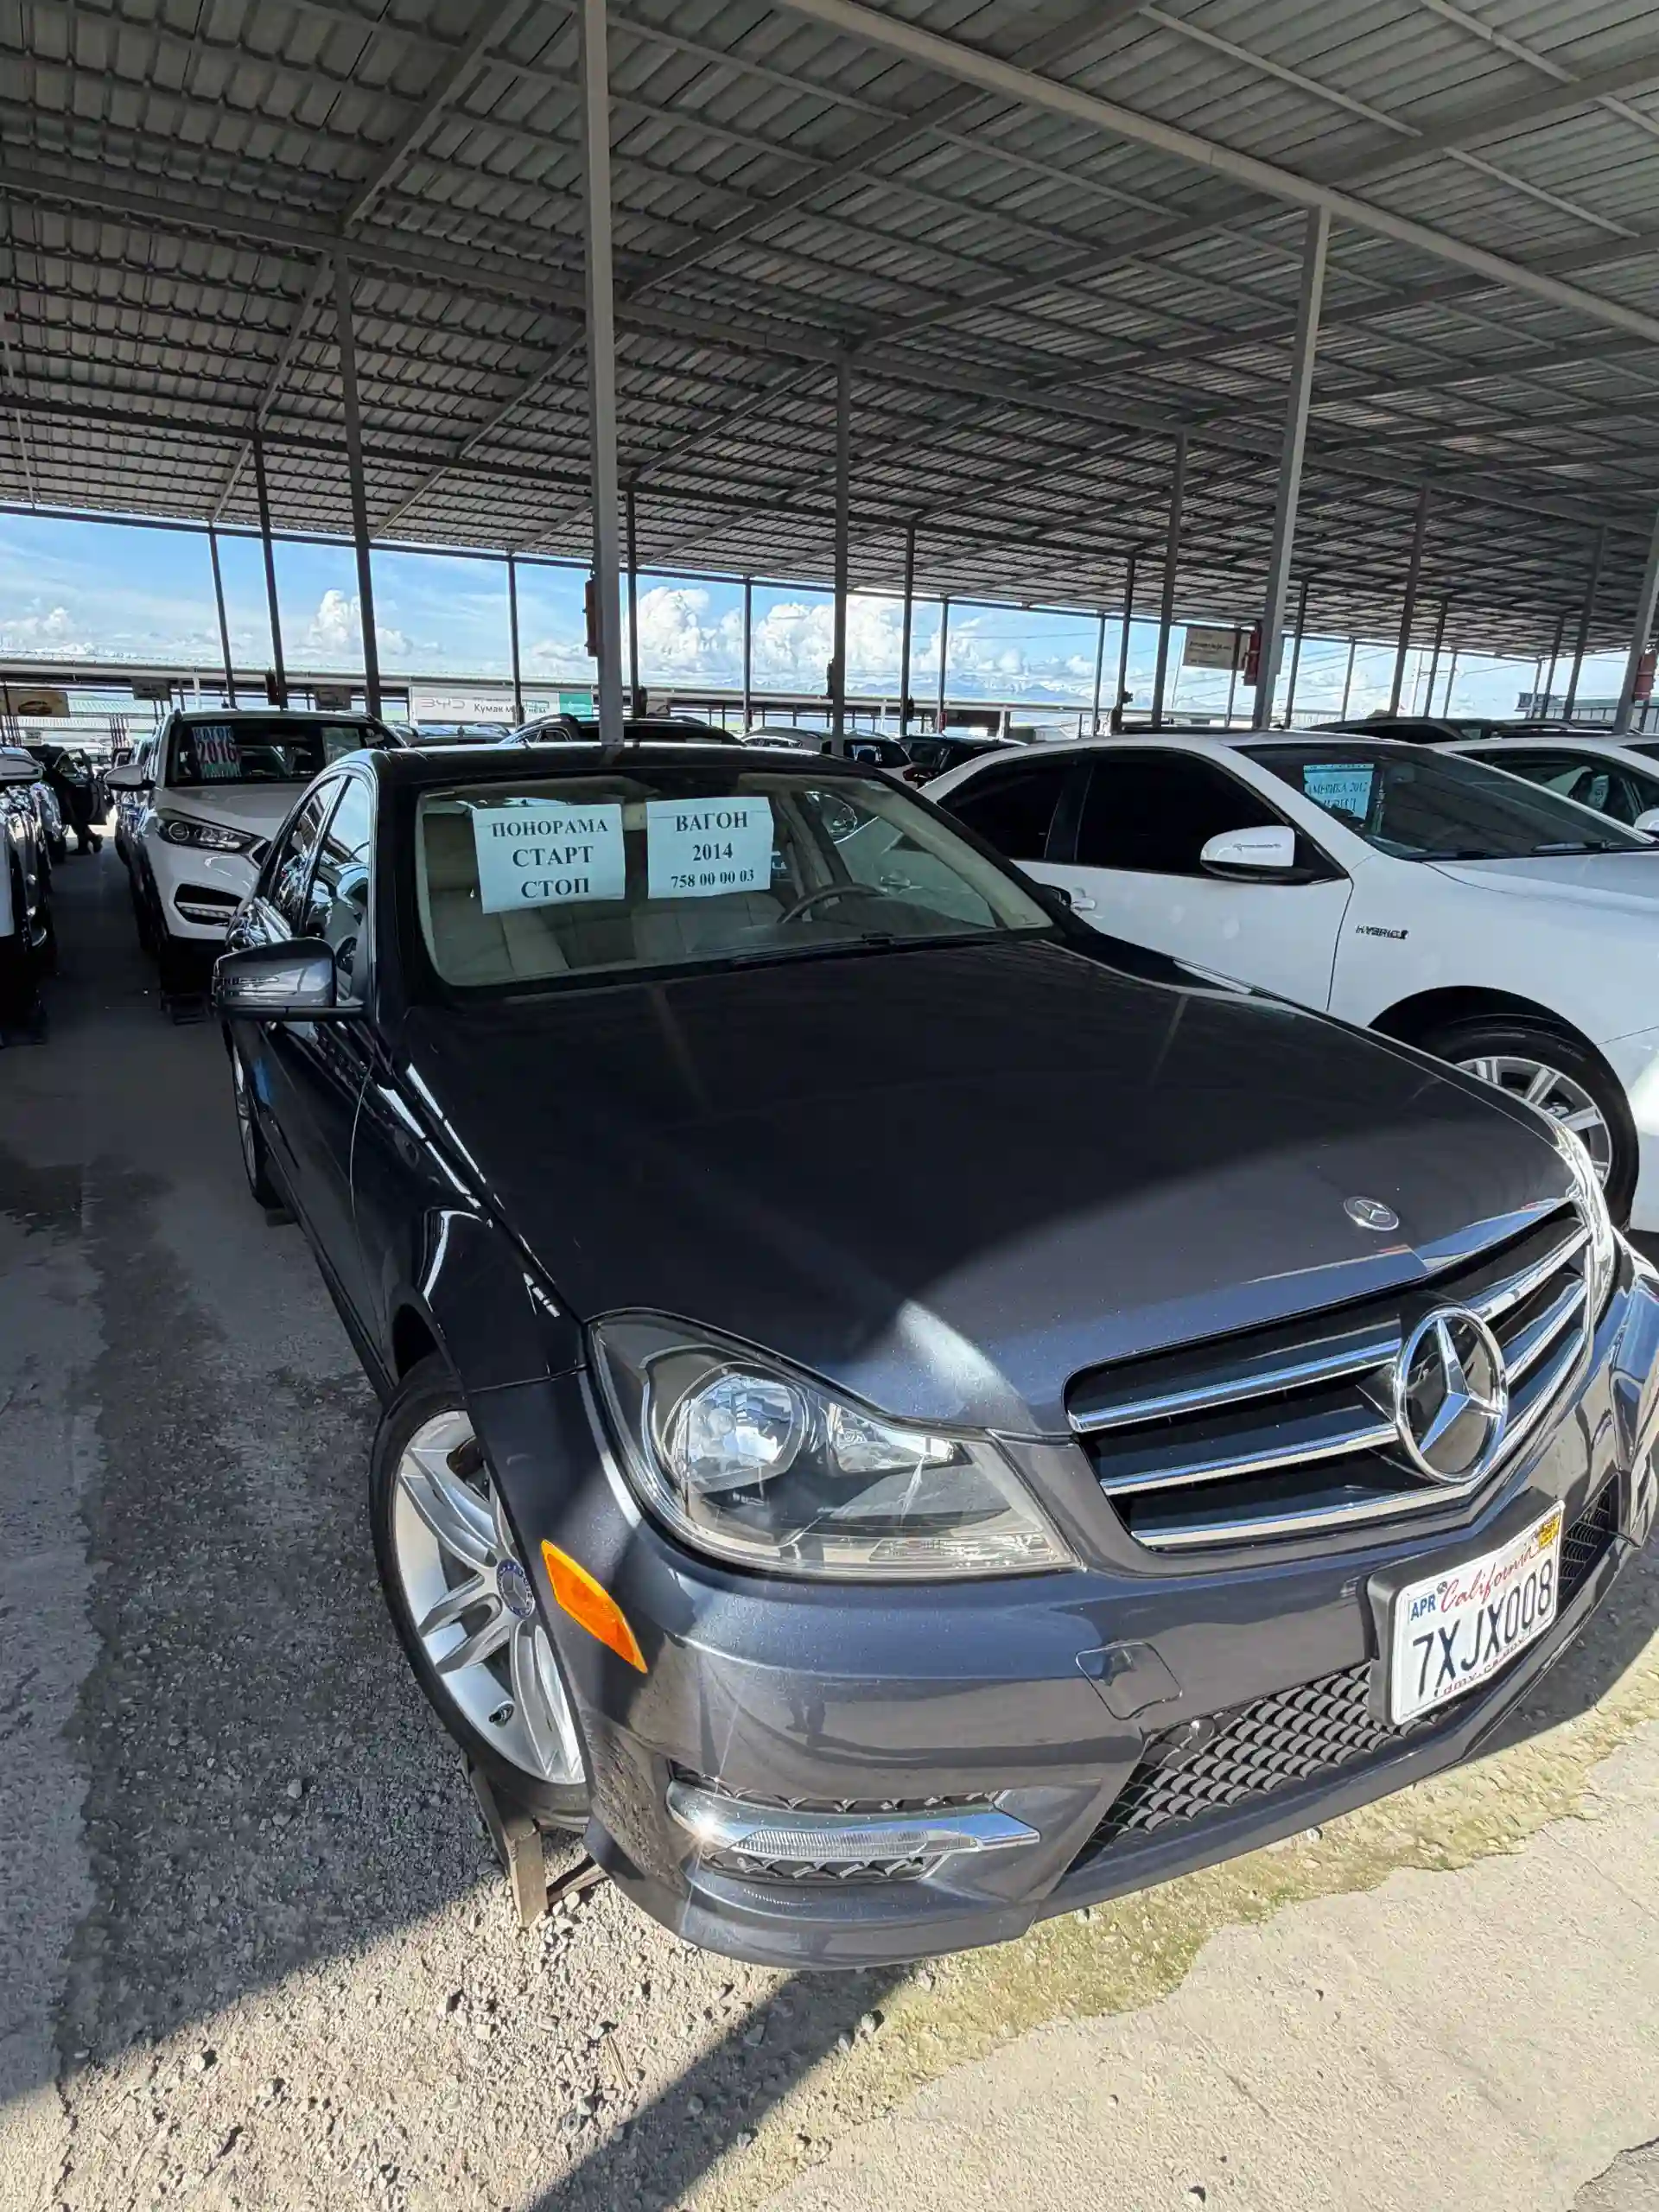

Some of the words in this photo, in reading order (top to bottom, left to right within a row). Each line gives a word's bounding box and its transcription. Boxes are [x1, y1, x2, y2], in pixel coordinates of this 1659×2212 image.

[420, 698, 465, 709] BYD
[197, 741, 239, 763] 2016
[491, 818, 608, 837] ПОНОРАМА
[675, 810, 748, 832] ВАГОН
[512, 846, 594, 868] СТАРТ
[693, 842, 733, 862] 2014
[521, 877, 589, 899] СТОП
[671, 874, 695, 888] 758
[700, 872, 715, 886] 00
[720, 871, 735, 885] 00
[740, 869, 754, 883] 03
[1411, 1594, 1436, 1622] APR
[1441, 1542, 1537, 1613] California
[1413, 1558, 1553, 1698] 7XJX008
